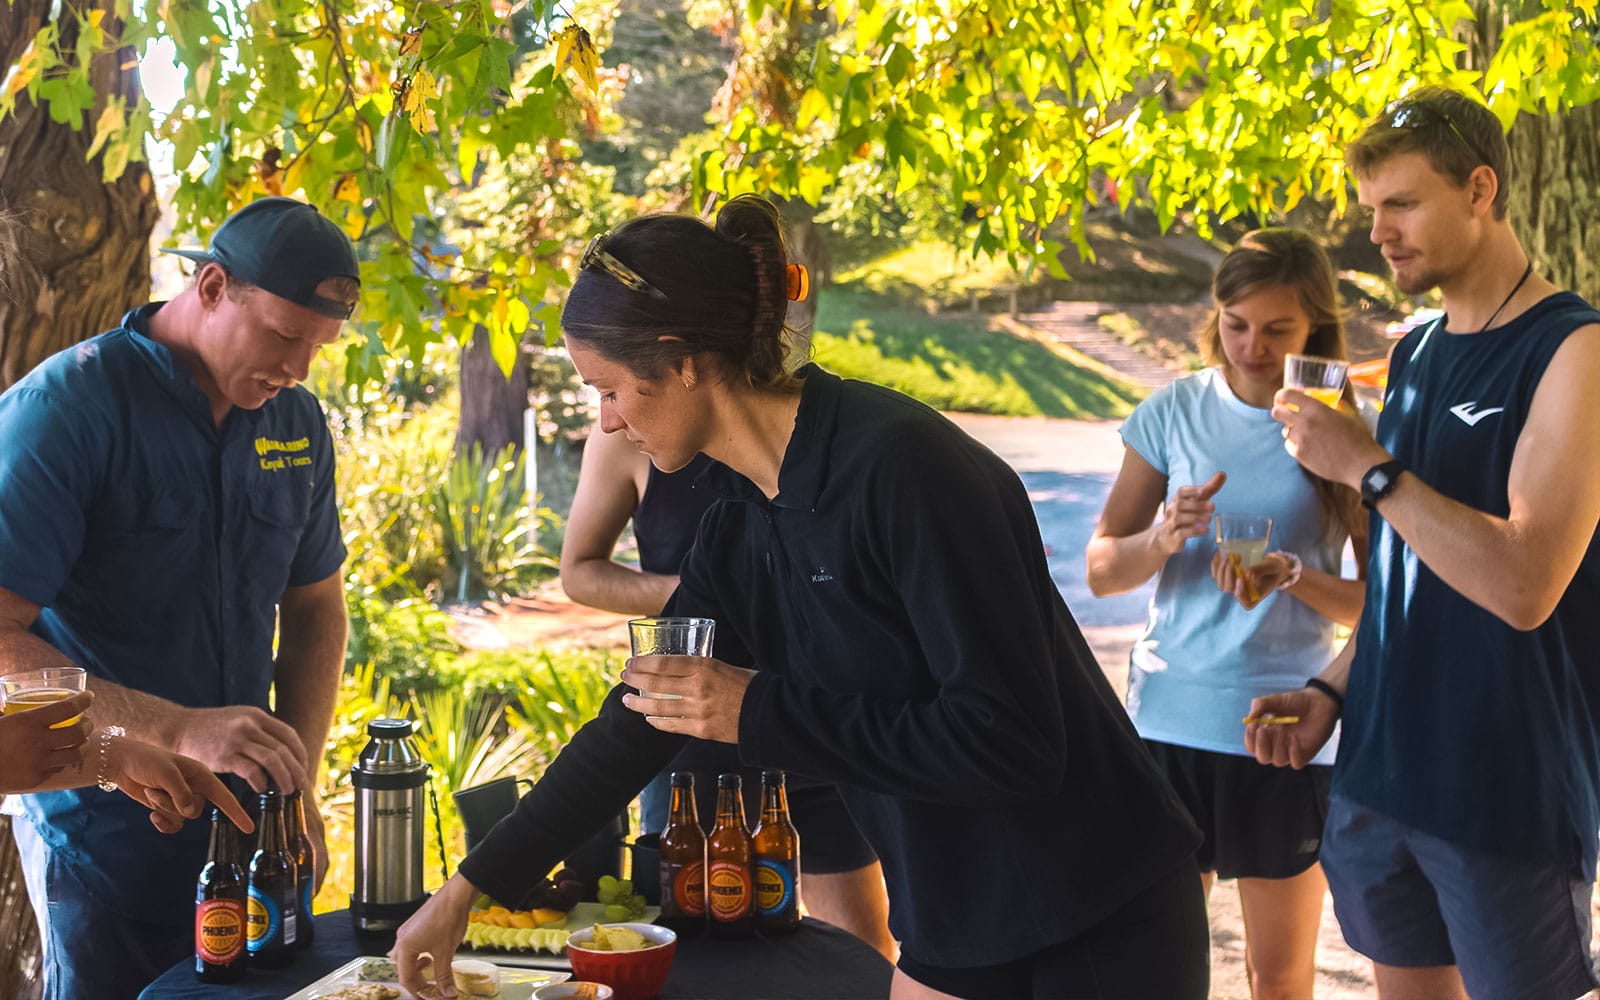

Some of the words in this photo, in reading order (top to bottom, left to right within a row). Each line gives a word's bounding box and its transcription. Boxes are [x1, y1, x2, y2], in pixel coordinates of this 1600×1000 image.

[285, 456, 312, 467] Tours
[247, 914, 266, 925] ENIX
[202, 925, 240, 937] PHOENIX
